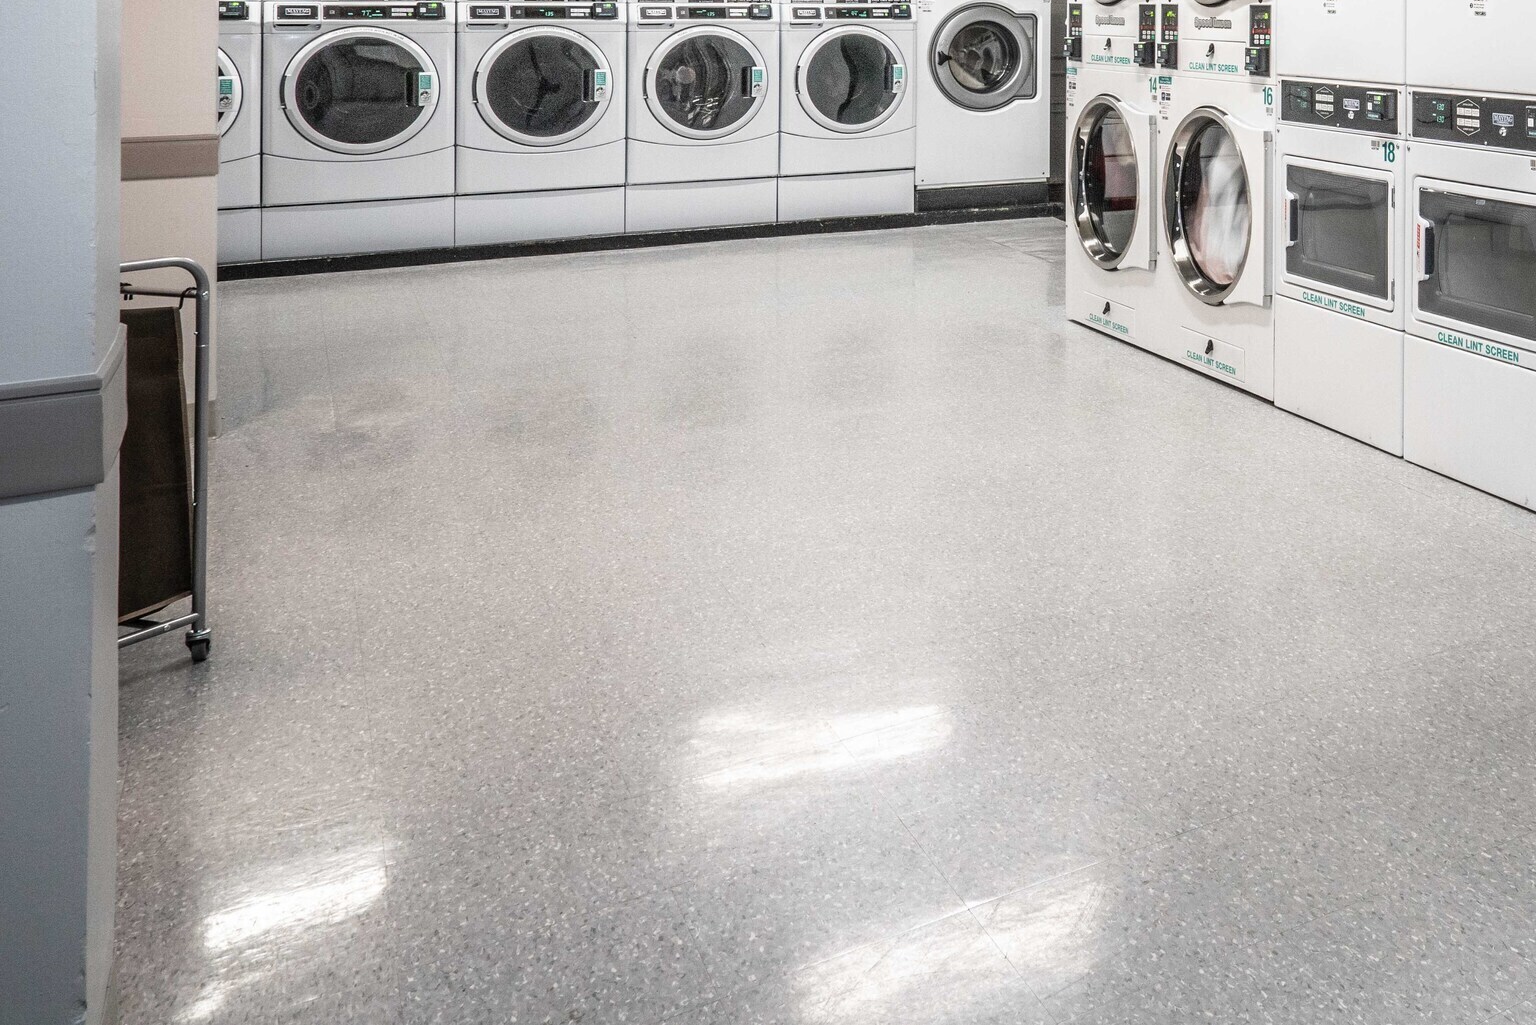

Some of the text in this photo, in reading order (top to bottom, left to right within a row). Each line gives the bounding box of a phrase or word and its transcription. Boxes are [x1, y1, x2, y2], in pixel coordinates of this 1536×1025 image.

[1189, 62, 1239, 73] CLEAN LINT SCREEN
[1149, 76, 1157, 93] 14
[1262, 86, 1273, 105] 16
[1382, 141, 1395, 162] 18
[1302, 291, 1365, 317] CLEAN LINT SCREEN
[1089, 313, 1128, 334] CLEAN LINT SCREEN
[1437, 332, 1519, 362] CLEAN LINT SCREEN
[1187, 350, 1236, 375] CLEAN LINT SCREEN
